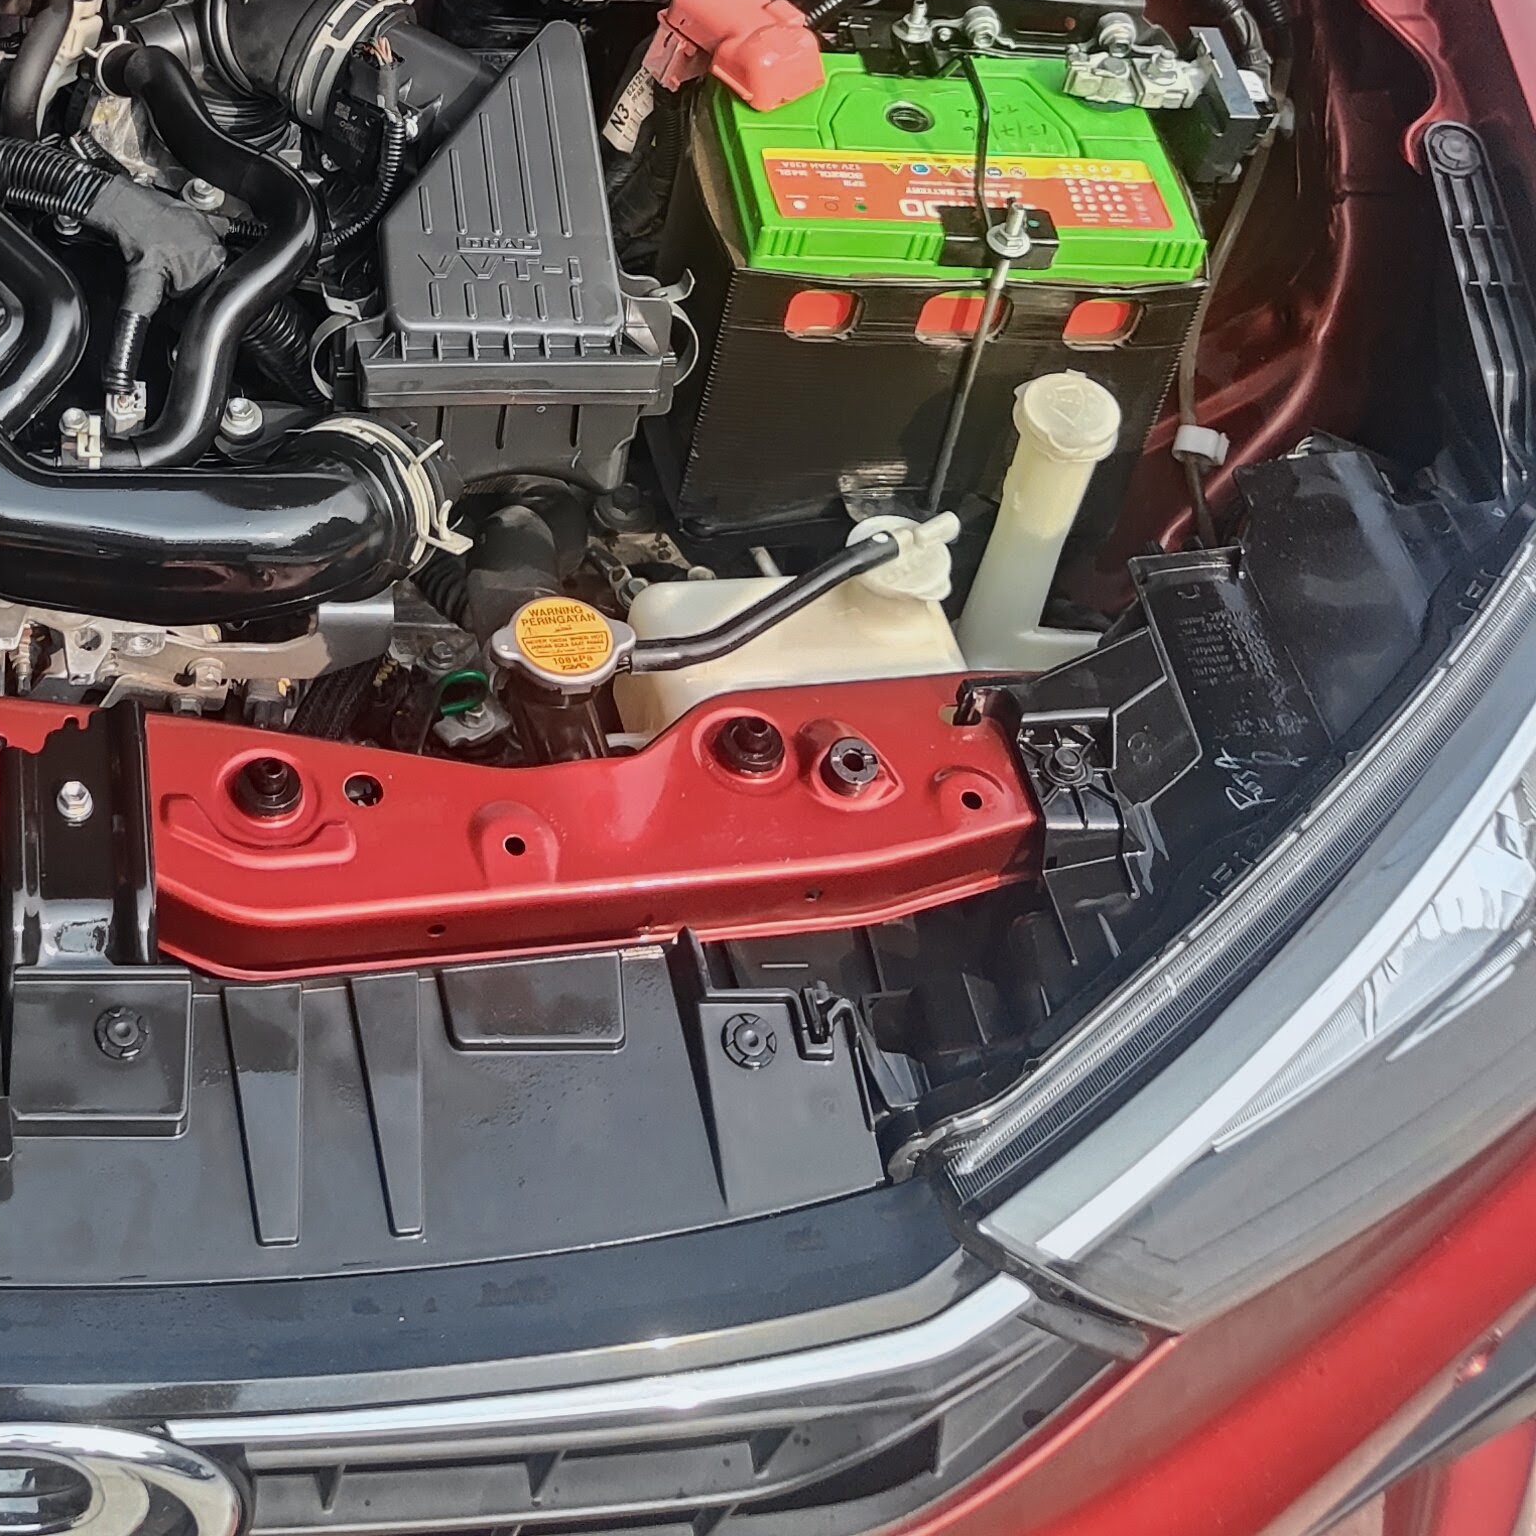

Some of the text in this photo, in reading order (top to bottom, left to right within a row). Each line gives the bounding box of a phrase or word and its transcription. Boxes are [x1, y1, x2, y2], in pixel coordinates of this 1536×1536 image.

[610, 103, 630, 134] N3
[465, 236, 534, 250] DUAL
[527, 605, 583, 618] WARNING
[521, 613, 596, 627] PERINGATAN
